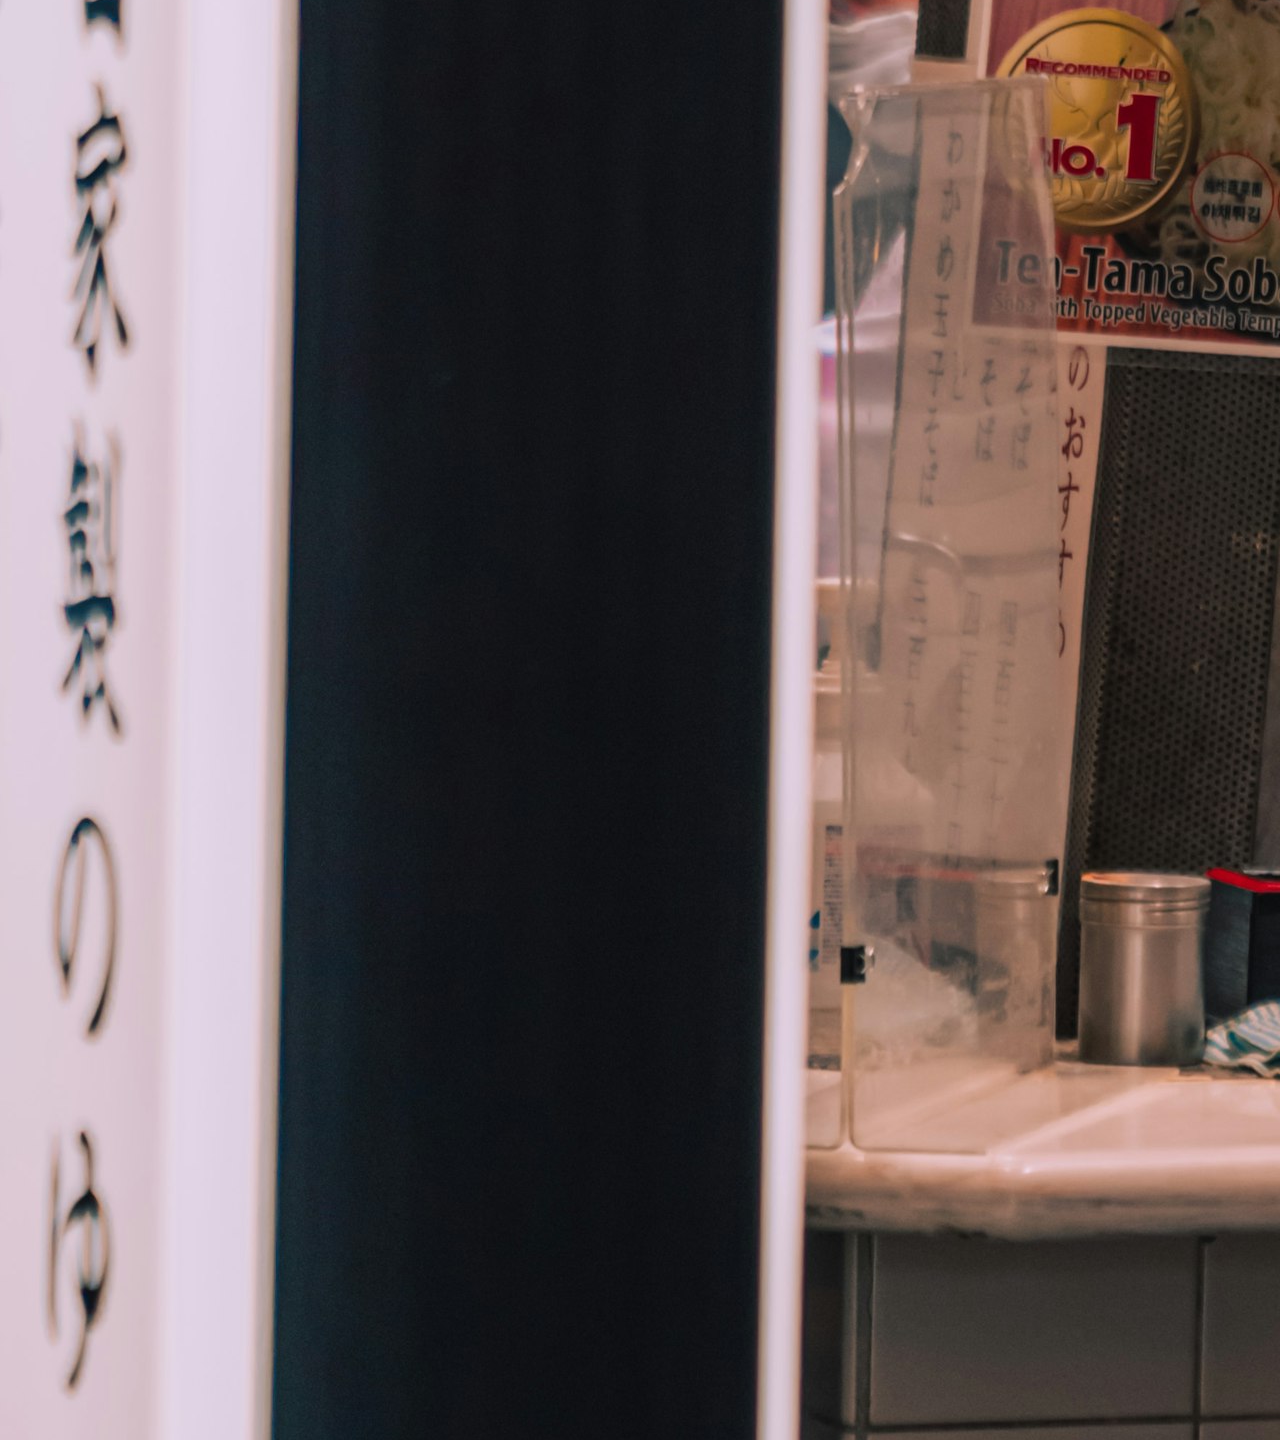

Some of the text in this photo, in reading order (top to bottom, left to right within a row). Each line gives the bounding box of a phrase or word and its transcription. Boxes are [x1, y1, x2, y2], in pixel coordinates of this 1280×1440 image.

[1025, 57, 1172, 84] RECOMMENDED
[997, 240, 1193, 300] Ten-Tama
[1047, 298, 1078, 319] ith
[1083, 301, 1145, 328] Topped
[1148, 304, 1236, 330] Vegetable
[1057, 344, 1091, 658] のおすす
